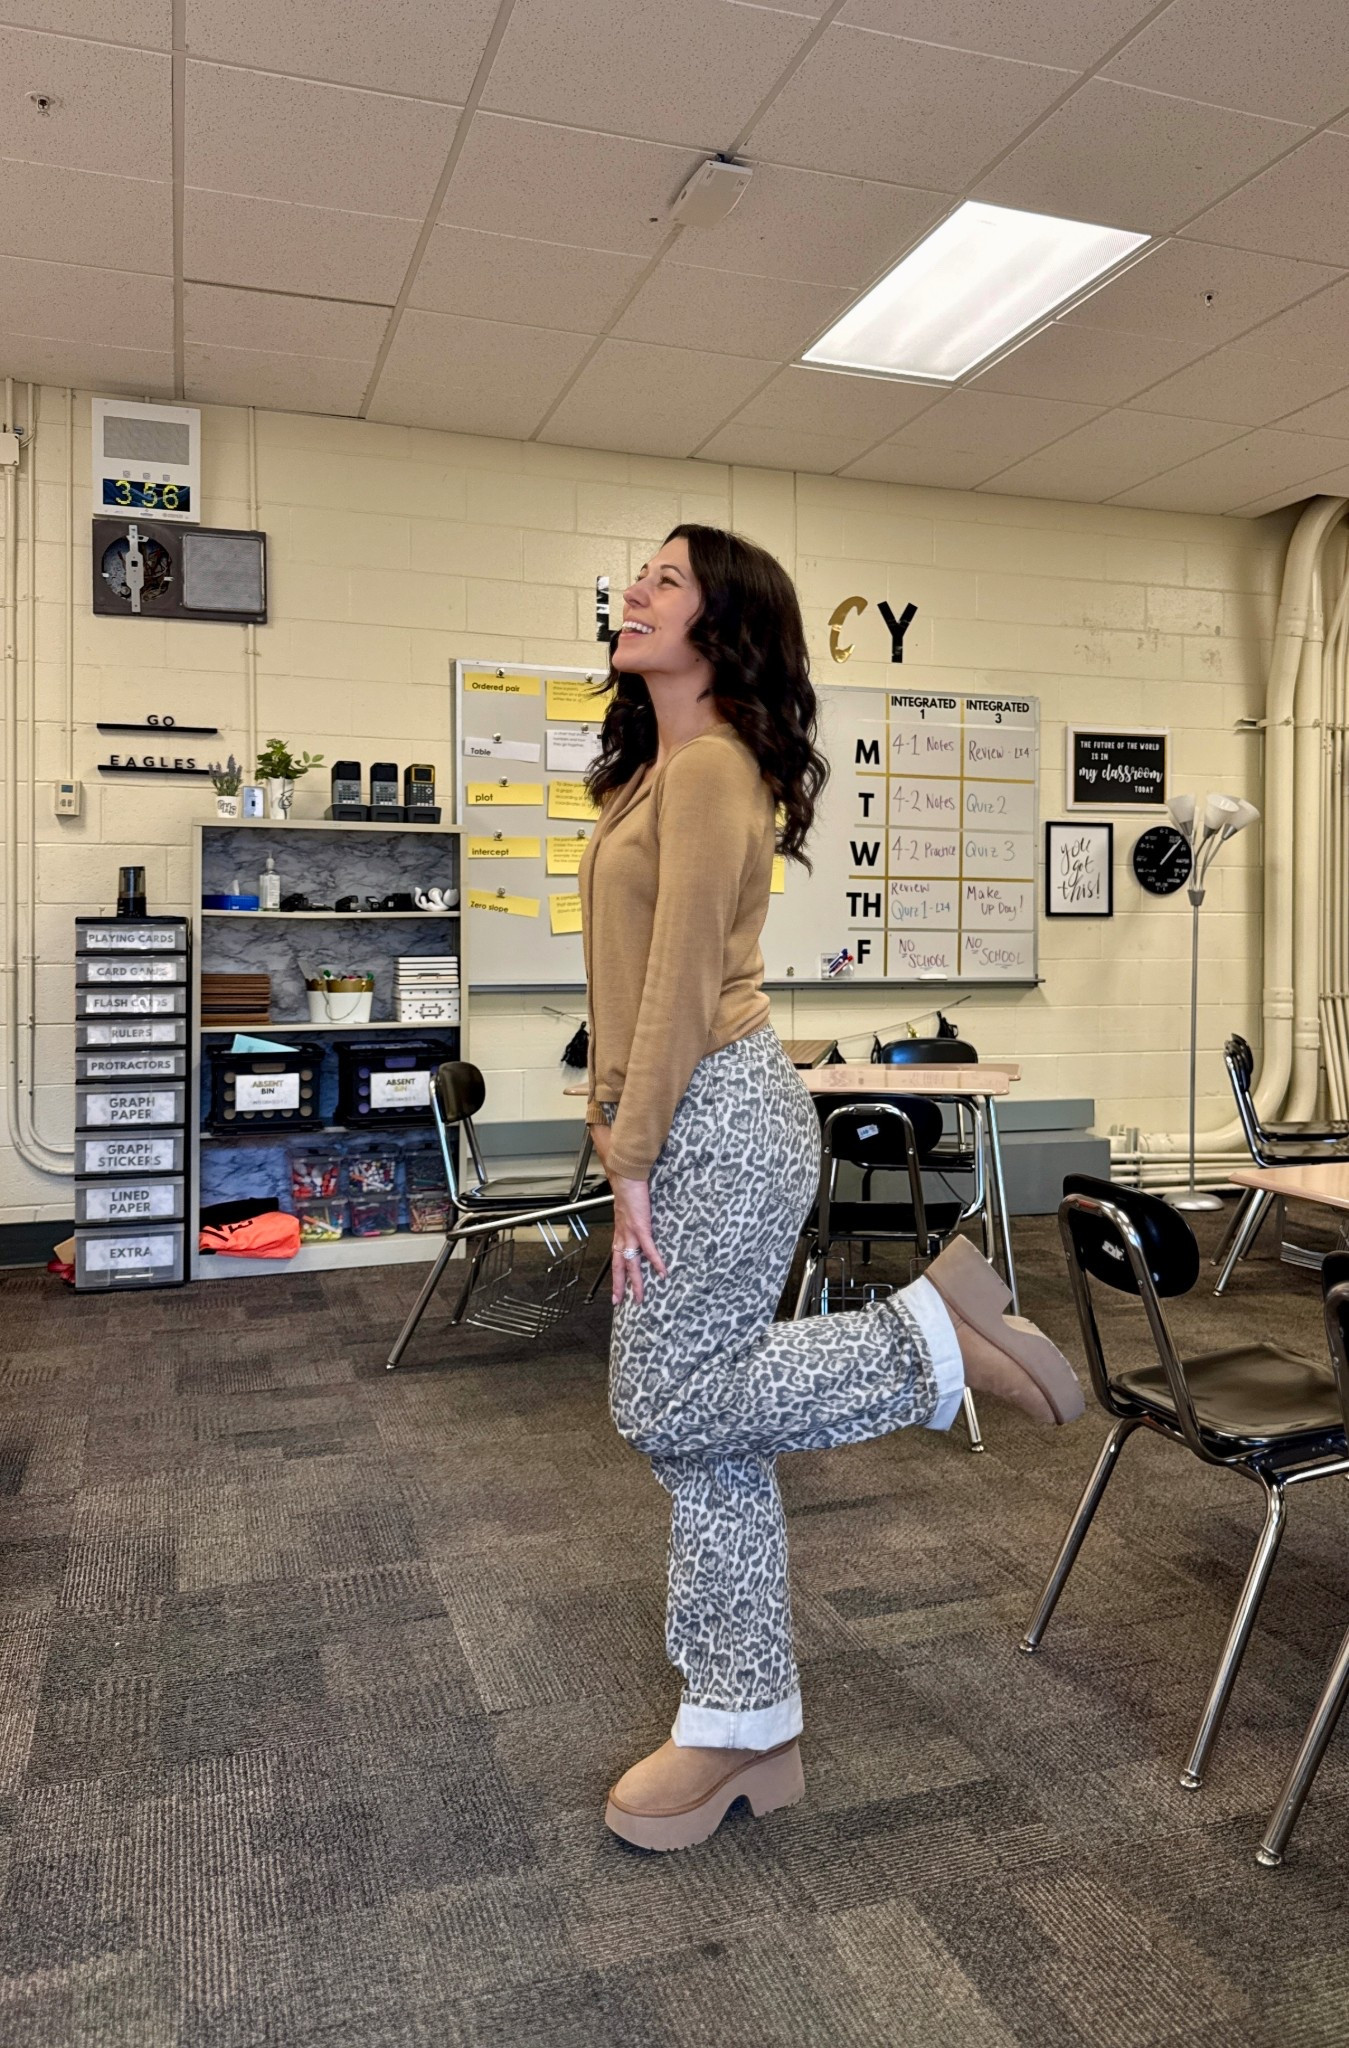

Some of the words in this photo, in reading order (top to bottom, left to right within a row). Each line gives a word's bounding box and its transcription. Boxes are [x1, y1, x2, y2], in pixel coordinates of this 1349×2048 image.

[471, 682, 504, 692] Ordered
[505, 685, 520, 693] pair
[891, 696, 957, 709] INTEGRATED
[966, 700, 1030, 713] INTEGRATED
[920, 709, 926, 720] 1
[994, 713, 1003, 724] 3
[147, 715, 175, 727] GO
[926, 736, 954, 752] Notes
[1080, 740, 1092, 749] THE
[1093, 741, 1115, 750] FUTURE
[1117, 742, 1125, 750] OF
[1126, 742, 1138, 750] THE
[1139, 742, 1160, 751] WORLD
[470, 747, 491, 757] Table
[855, 739, 880, 765] M
[969, 740, 1004, 762] Review
[1091, 752, 1099, 760] IS
[1100, 752, 1109, 761] IN
[110, 755, 196, 769] EAGLES
[1079, 766, 1099, 784] my
[1101, 763, 1163, 784] classroom
[1134, 785, 1154, 794] TODAY
[475, 793, 493, 803] plot
[926, 794, 955, 810] Notes
[966, 793, 995, 814] Quiz
[996, 795, 1008, 815] 2
[858, 792, 875, 817] T
[471, 848, 509, 856] intercept
[849, 840, 881, 867] W
[965, 840, 998, 858] Quiz
[1003, 840, 1016, 861] 3
[1060, 837, 1092, 876] you
[1067, 857, 1095, 887] got
[891, 882, 930, 896] Review
[966, 885, 1002, 901] Make
[470, 900, 487, 910] Zero
[488, 904, 509, 914] slope
[846, 892, 881, 918] TH
[88, 934, 135, 943] PLAYING
[138, 934, 174, 943] CARDS
[965, 935, 983, 949] NO
[857, 939, 871, 964] F
[899, 938, 915, 954] NO
[96, 967, 127, 976] CARD
[94, 998, 128, 1007] FLASH
[112, 1029, 152, 1038] RULERS
[91, 1060, 171, 1071] PROTRACTORS
[251, 1079, 284, 1088] ABSENT
[386, 1078, 416, 1086] ABSENT
[109, 1097, 155, 1108] GRAPH
[111, 1109, 151, 1120] PAPER
[107, 1144, 153, 1155] GRAPH
[98, 1155, 161, 1167] STICKERS
[111, 1190, 150, 1202] LINED
[109, 1202, 151, 1214] PAPER
[109, 1247, 153, 1259] EXTRA
